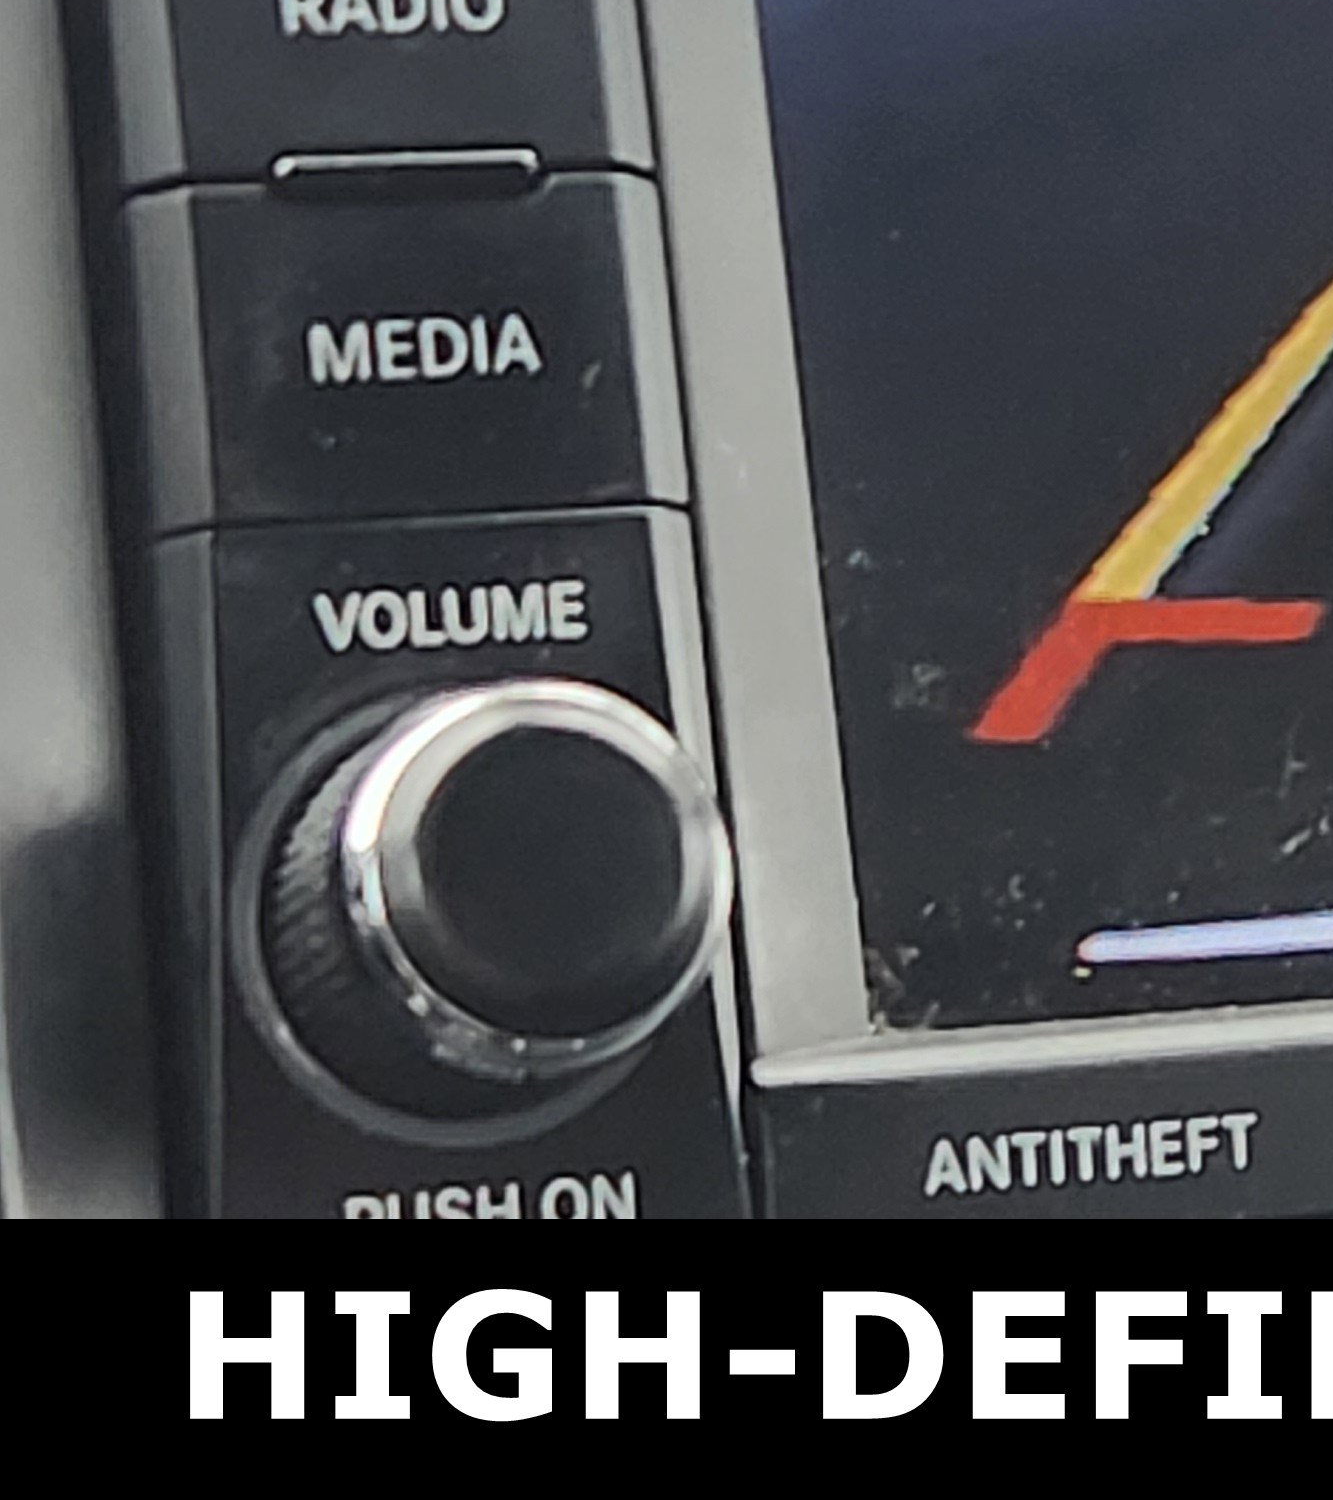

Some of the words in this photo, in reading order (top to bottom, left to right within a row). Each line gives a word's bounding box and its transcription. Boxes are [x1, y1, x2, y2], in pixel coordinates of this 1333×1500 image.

[307, 312, 543, 384] MEDIA
[312, 579, 589, 652] VOLUME
[924, 1111, 1259, 1197] ANTITHEFT
[540, 1170, 637, 1219] ON
